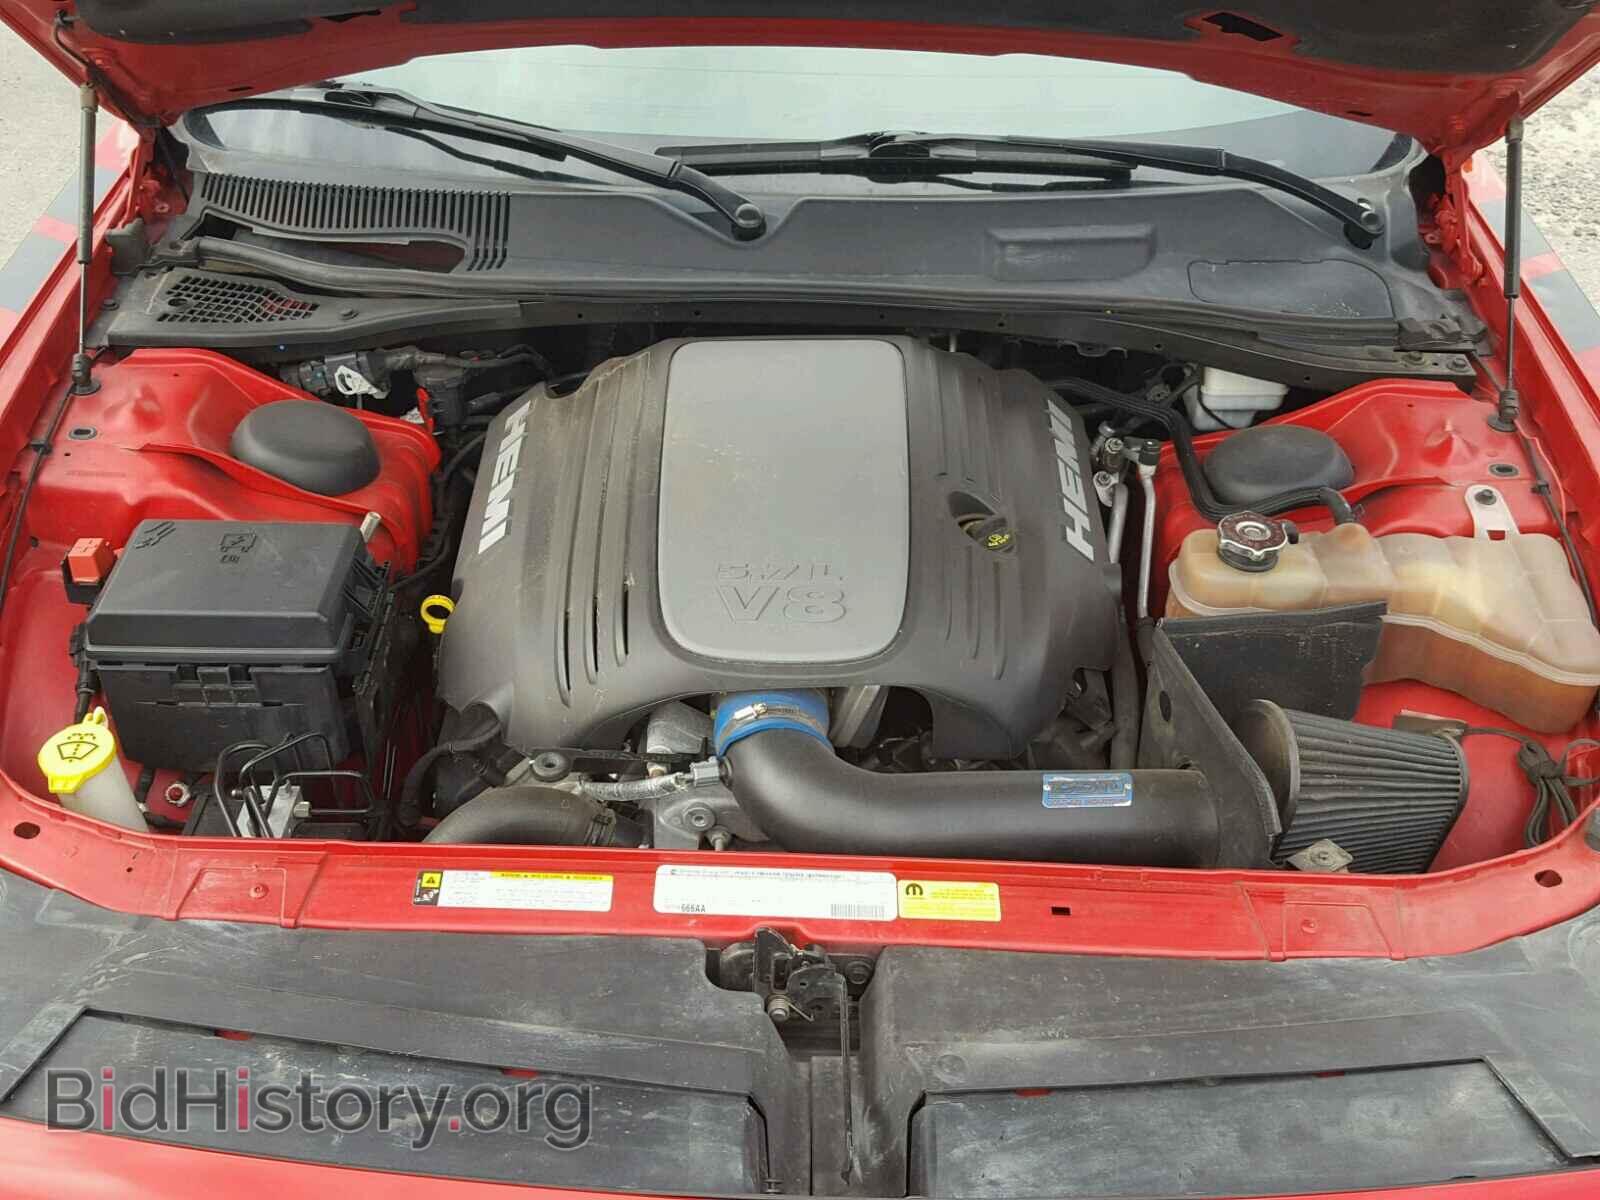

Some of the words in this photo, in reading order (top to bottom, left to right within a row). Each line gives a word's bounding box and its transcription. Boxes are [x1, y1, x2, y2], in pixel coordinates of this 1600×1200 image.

[478, 400, 533, 554] HEMI
[1047, 400, 1095, 561] HEMI
[715, 585, 848, 624] V8
